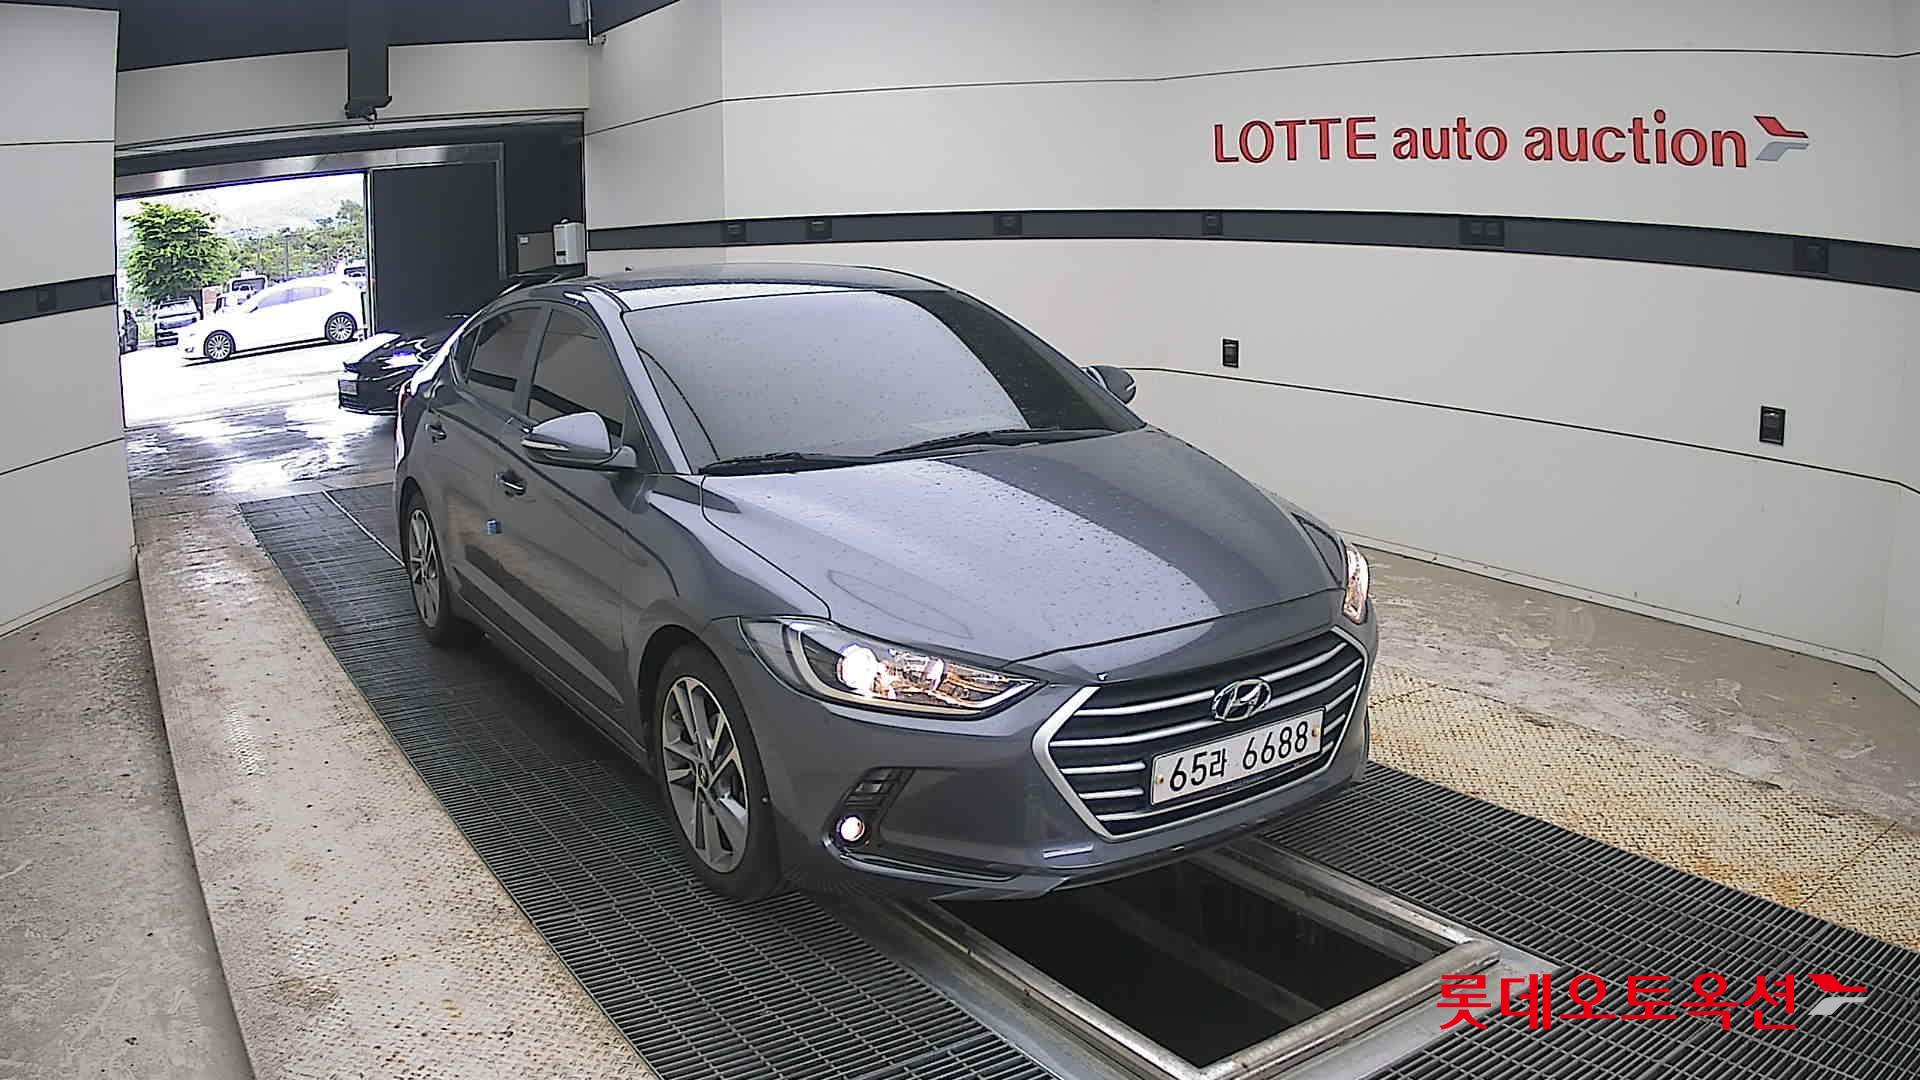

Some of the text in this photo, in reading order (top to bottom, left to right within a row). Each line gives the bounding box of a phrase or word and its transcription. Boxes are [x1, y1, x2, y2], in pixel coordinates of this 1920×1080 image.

[1213, 109, 1749, 168] LOTTE auto auction
[1169, 720, 1309, 791] 65라 6688
